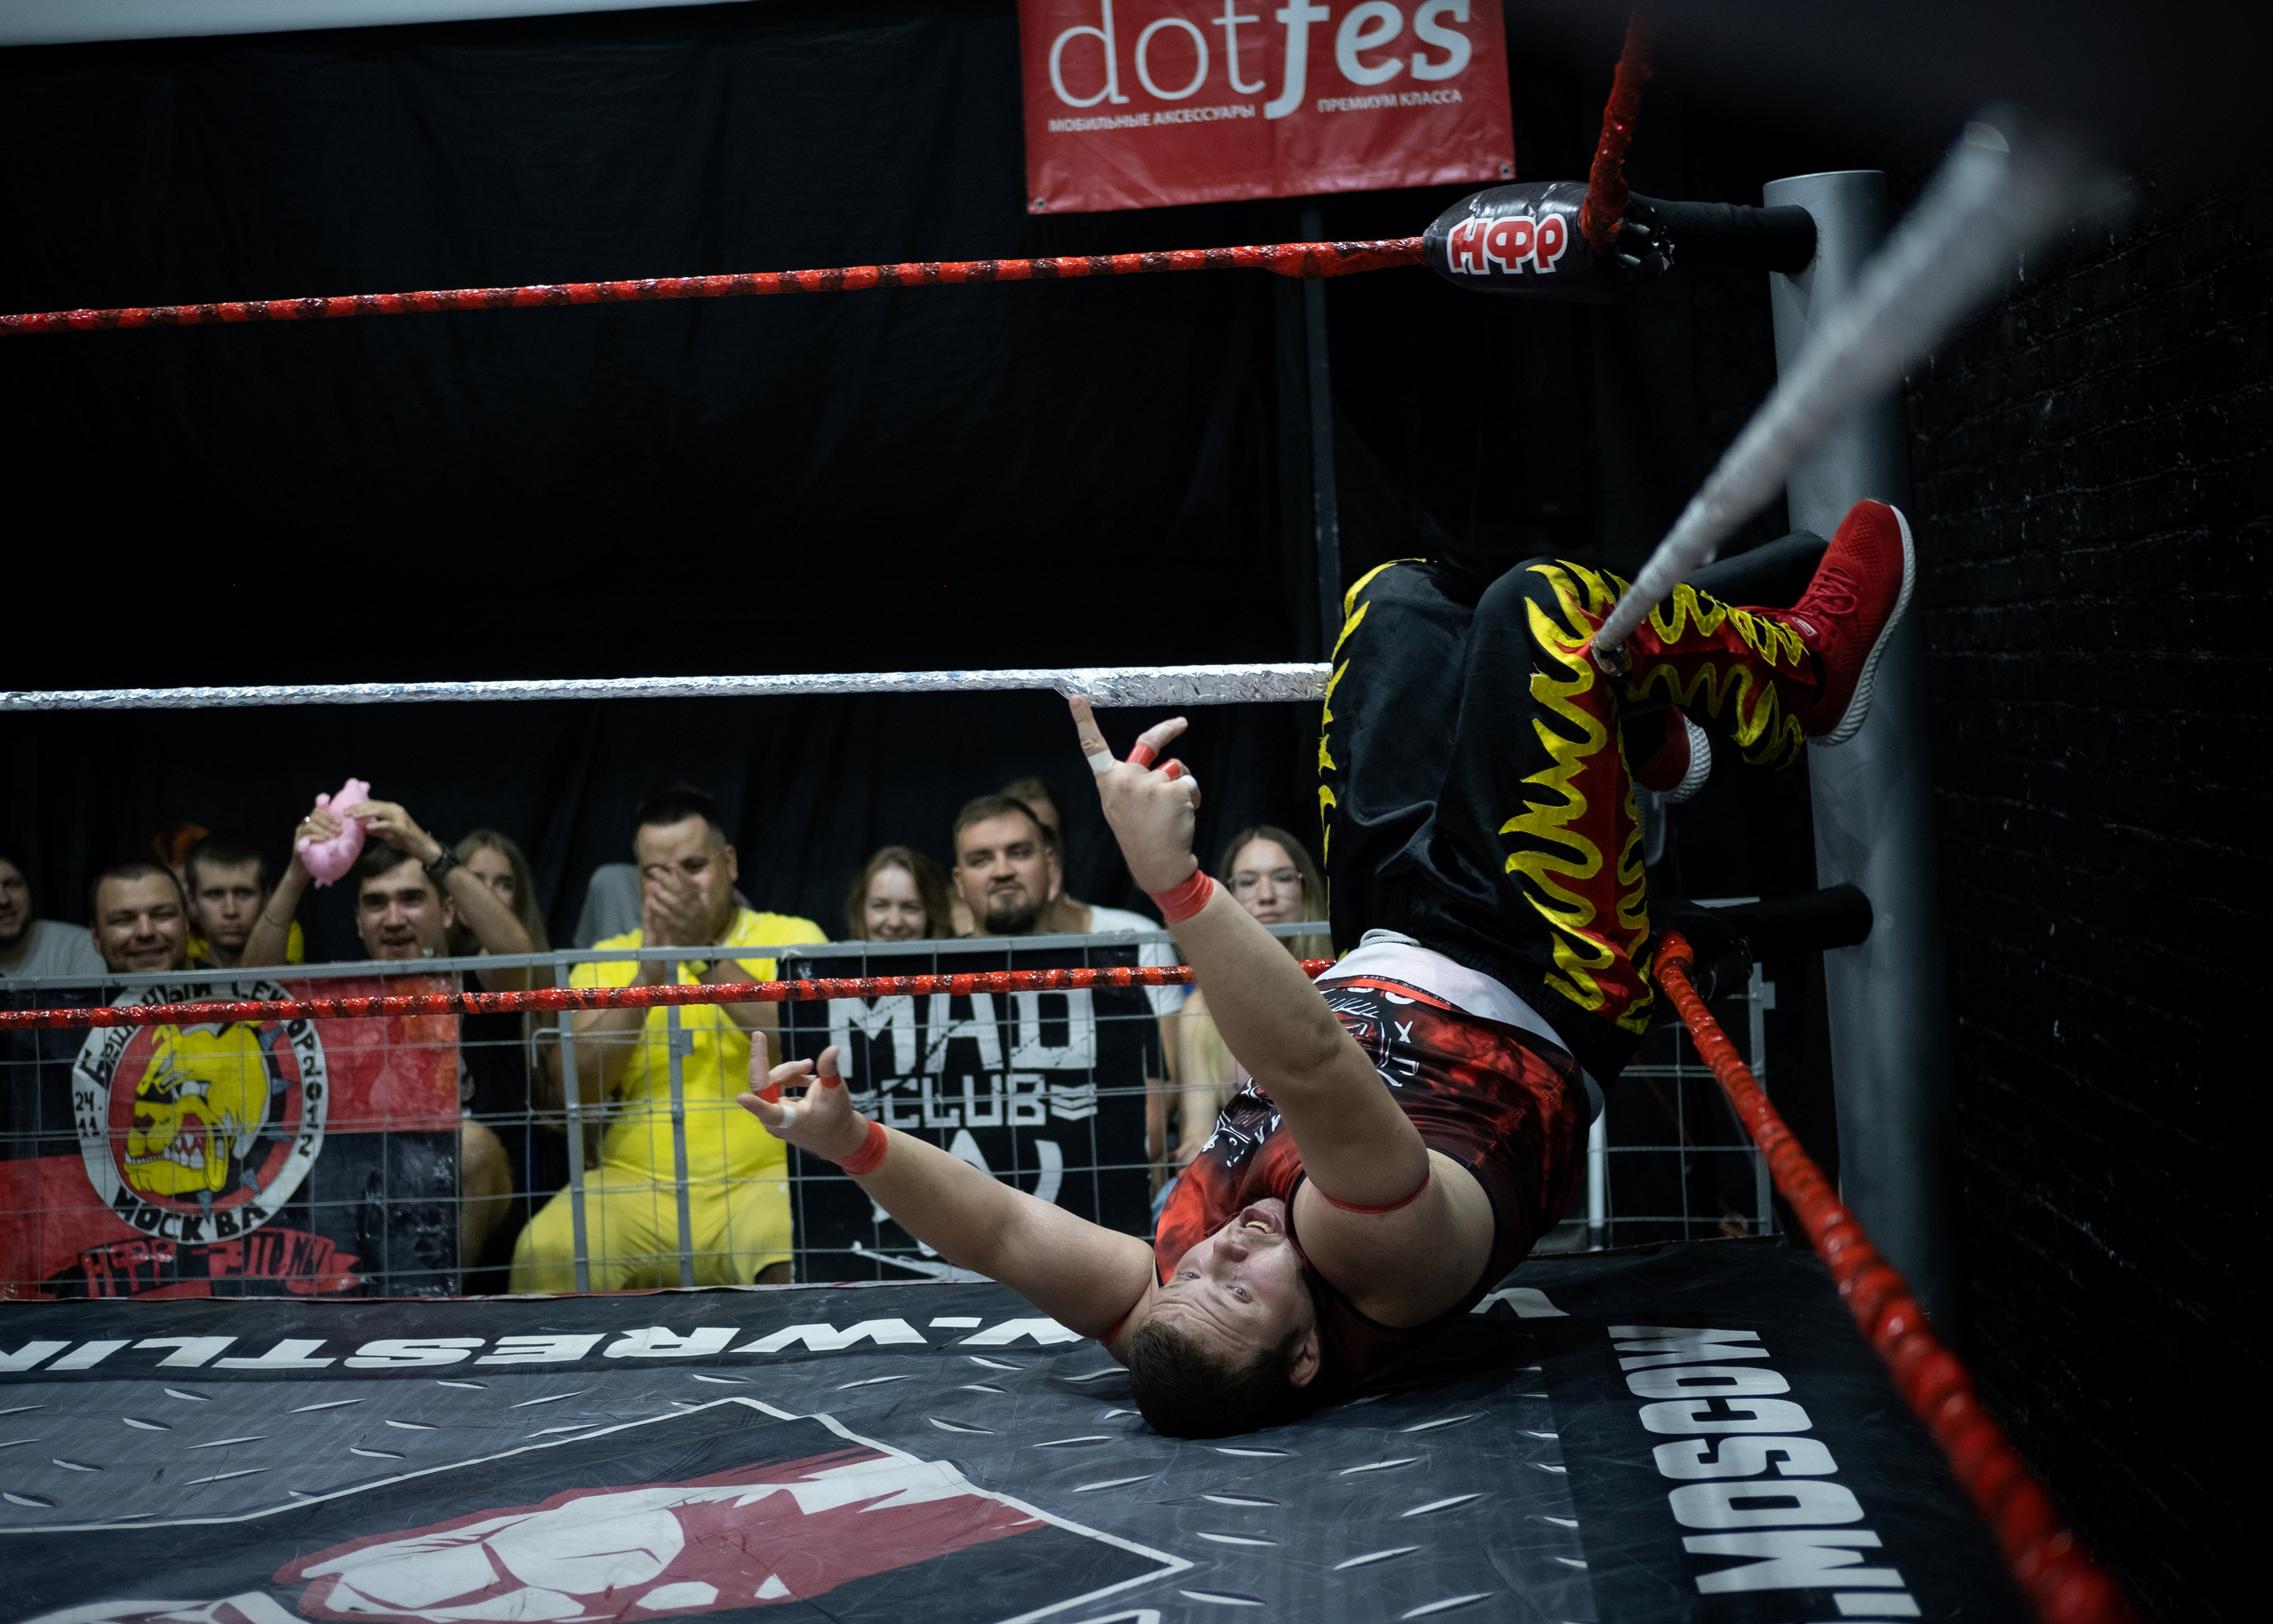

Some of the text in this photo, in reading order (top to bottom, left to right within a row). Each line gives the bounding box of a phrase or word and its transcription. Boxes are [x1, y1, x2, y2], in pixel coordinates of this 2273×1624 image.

[1049, 0, 1472, 120] dotfes
[1048, 89, 1463, 132] МОБИЛЬНЫЕ АКСЕССУАРЫ ПРЕМИУМ КЛАССА
[1447, 214, 1567, 274] НФР
[828, 987, 1097, 1078] MAD
[881, 1073, 1047, 1129] CLUB
